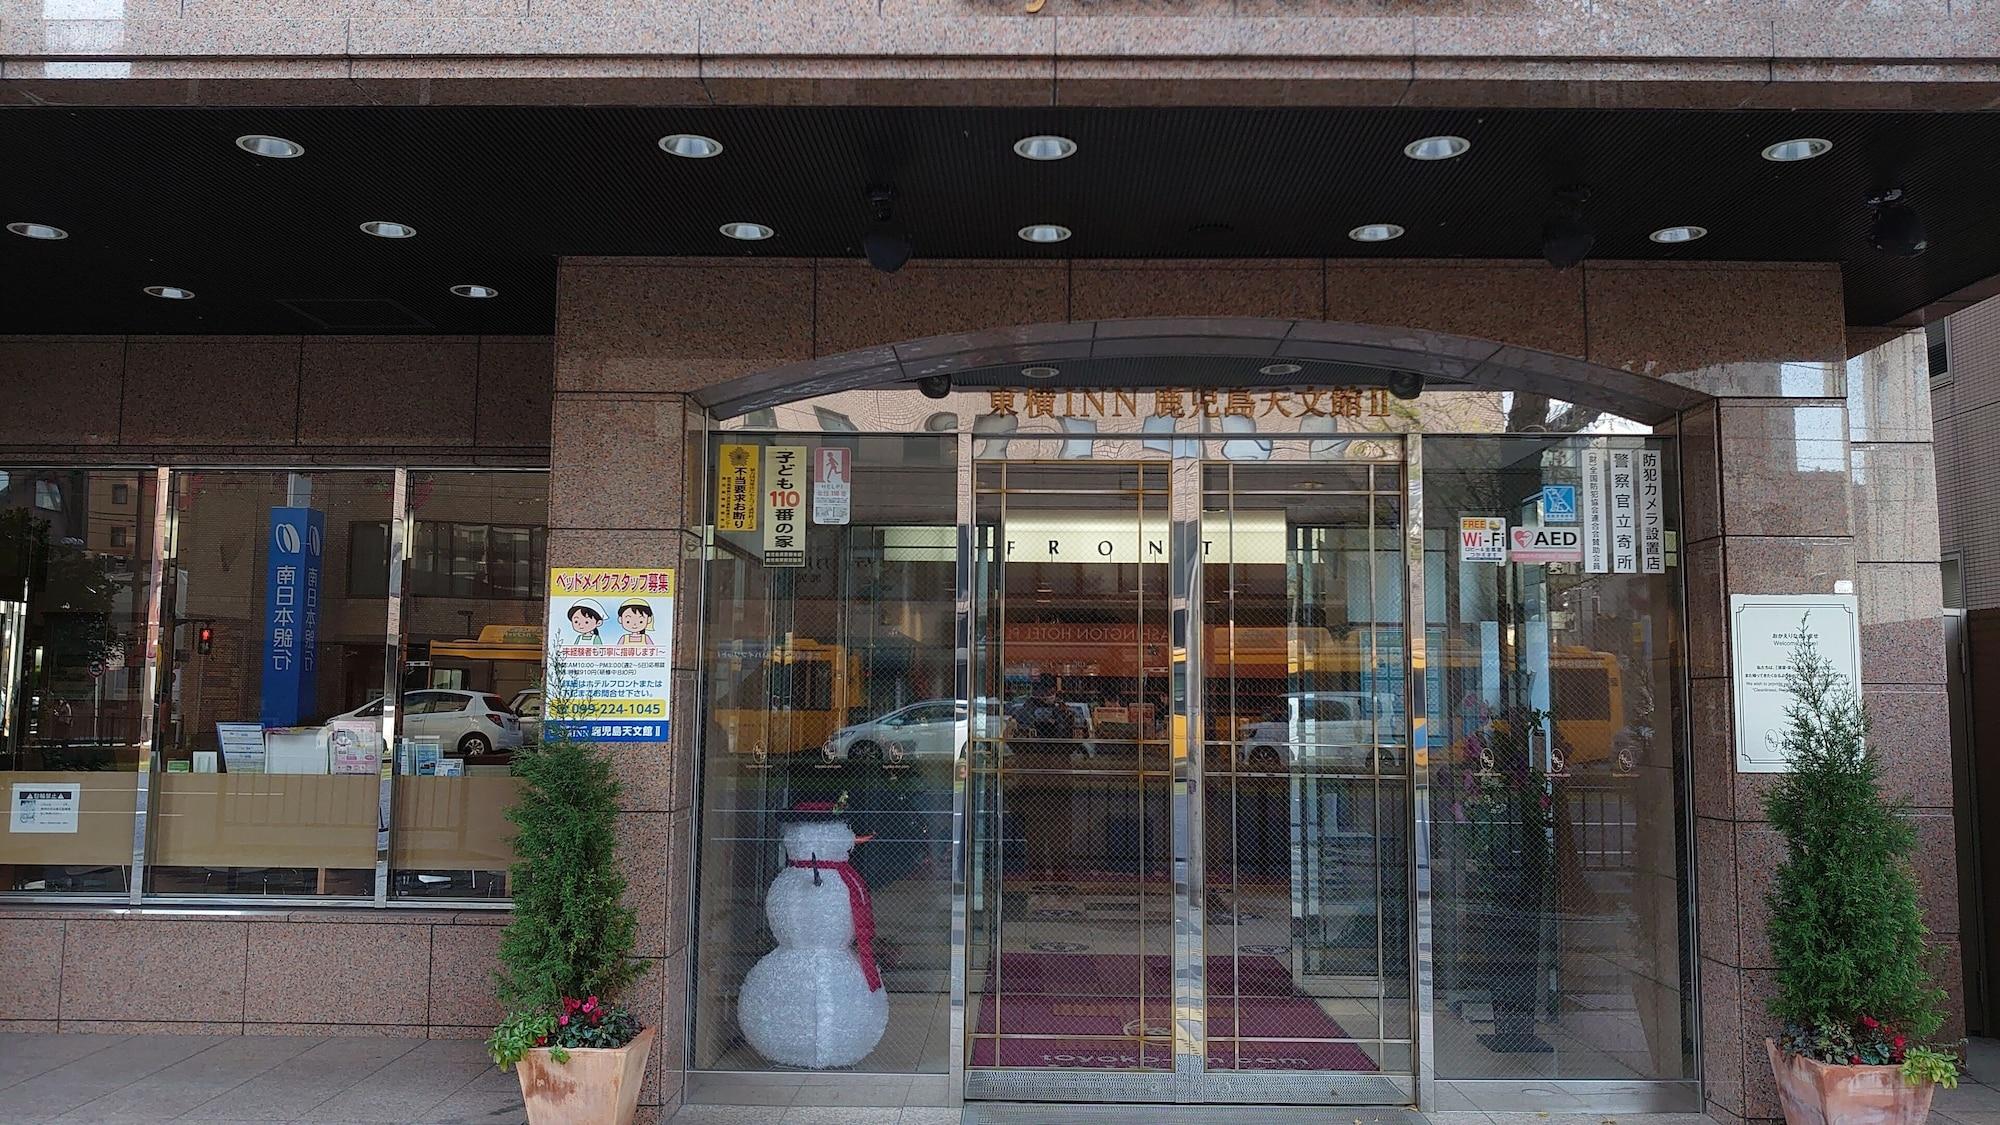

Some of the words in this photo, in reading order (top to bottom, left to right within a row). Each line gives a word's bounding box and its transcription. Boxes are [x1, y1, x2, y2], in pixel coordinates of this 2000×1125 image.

[987, 386, 1137, 418] 東横INN
[733, 467, 748, 529] 不当要求お断り
[769, 451, 800, 548] 子ども110番の家
[1463, 520, 1486, 529] FREE
[1614, 453, 1632, 570] 警察官立寄所
[1643, 453, 1660, 570] 防犯カメラ設置店
[1462, 532, 1505, 547] Wi-Fi
[1534, 531, 1577, 546] AED
[556, 573, 669, 593] ベッドメイクスタッフ募集
[571, 703, 661, 715] 099-224-1045
